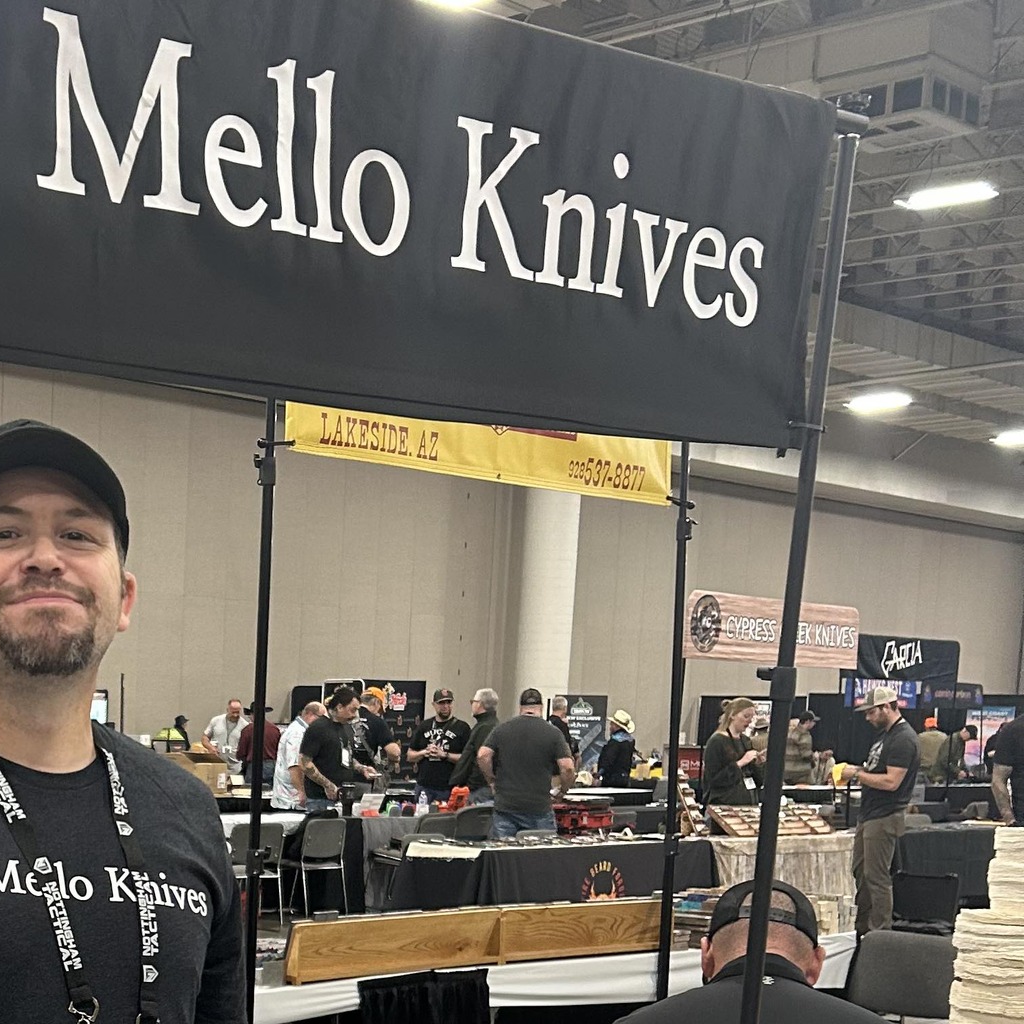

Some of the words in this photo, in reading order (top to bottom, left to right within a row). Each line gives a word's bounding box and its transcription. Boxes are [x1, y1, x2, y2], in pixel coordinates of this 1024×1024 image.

[36, 6, 411, 257] Mello
[450, 115, 765, 328] Knives
[416, 430, 439, 461] AZ
[726, 616, 776, 642] CYPRESS
[815, 622, 856, 648] KNIVES
[880, 640, 923, 678] GARCIA
[41, 882, 73, 972] TACTICAL
[48, 881, 83, 970] NOTTINGHAM
[131, 871, 151, 957] NOTTINGHAM
[141, 872, 159, 957] TACTICAL
